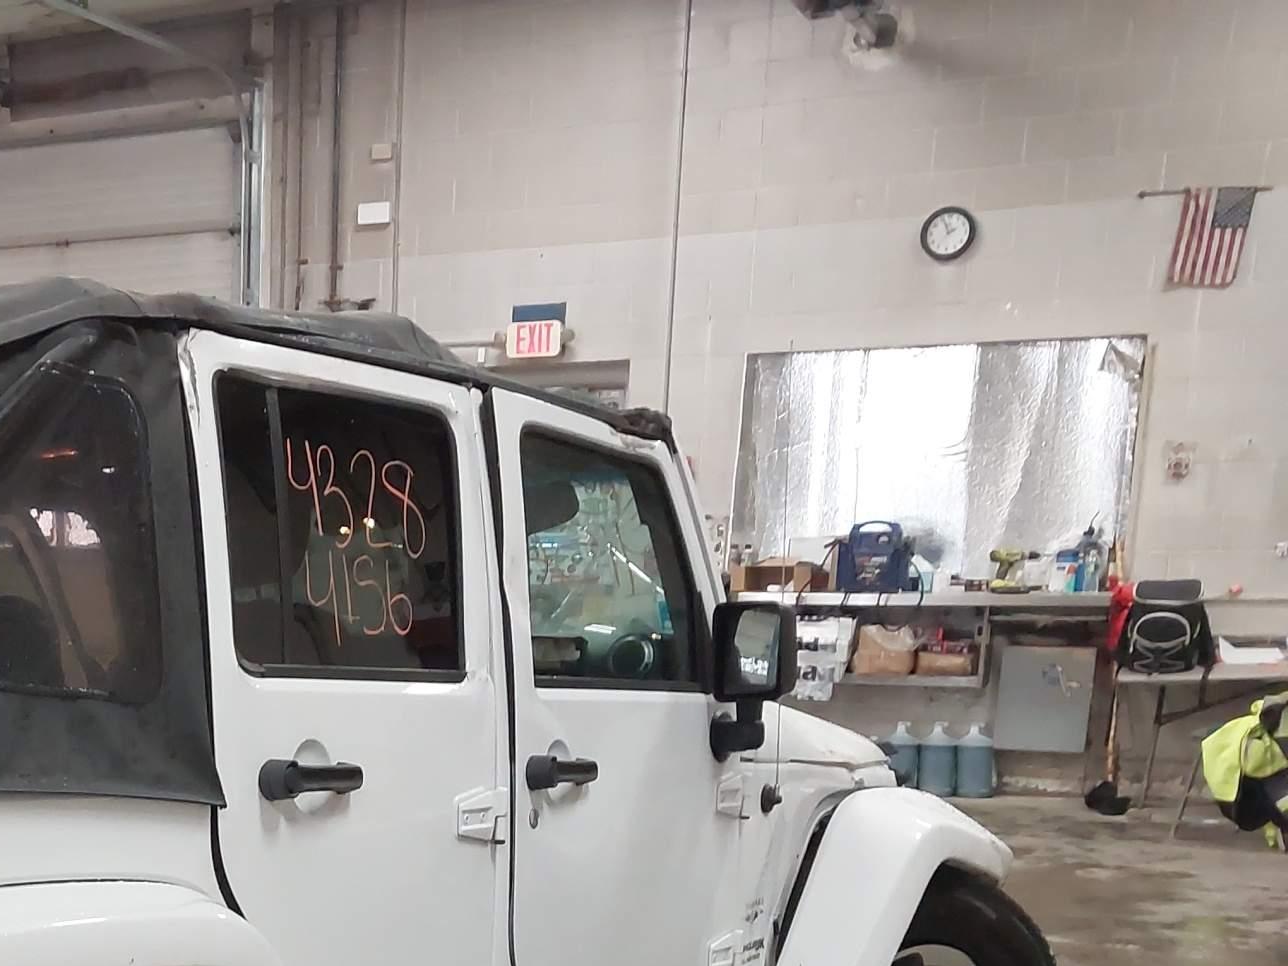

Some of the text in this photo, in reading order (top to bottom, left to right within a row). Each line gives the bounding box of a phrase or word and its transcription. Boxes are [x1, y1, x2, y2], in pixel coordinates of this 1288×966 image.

[515, 322, 554, 354] EXIT
[286, 437, 426, 559] 4328
[304, 549, 414, 648] 4156
